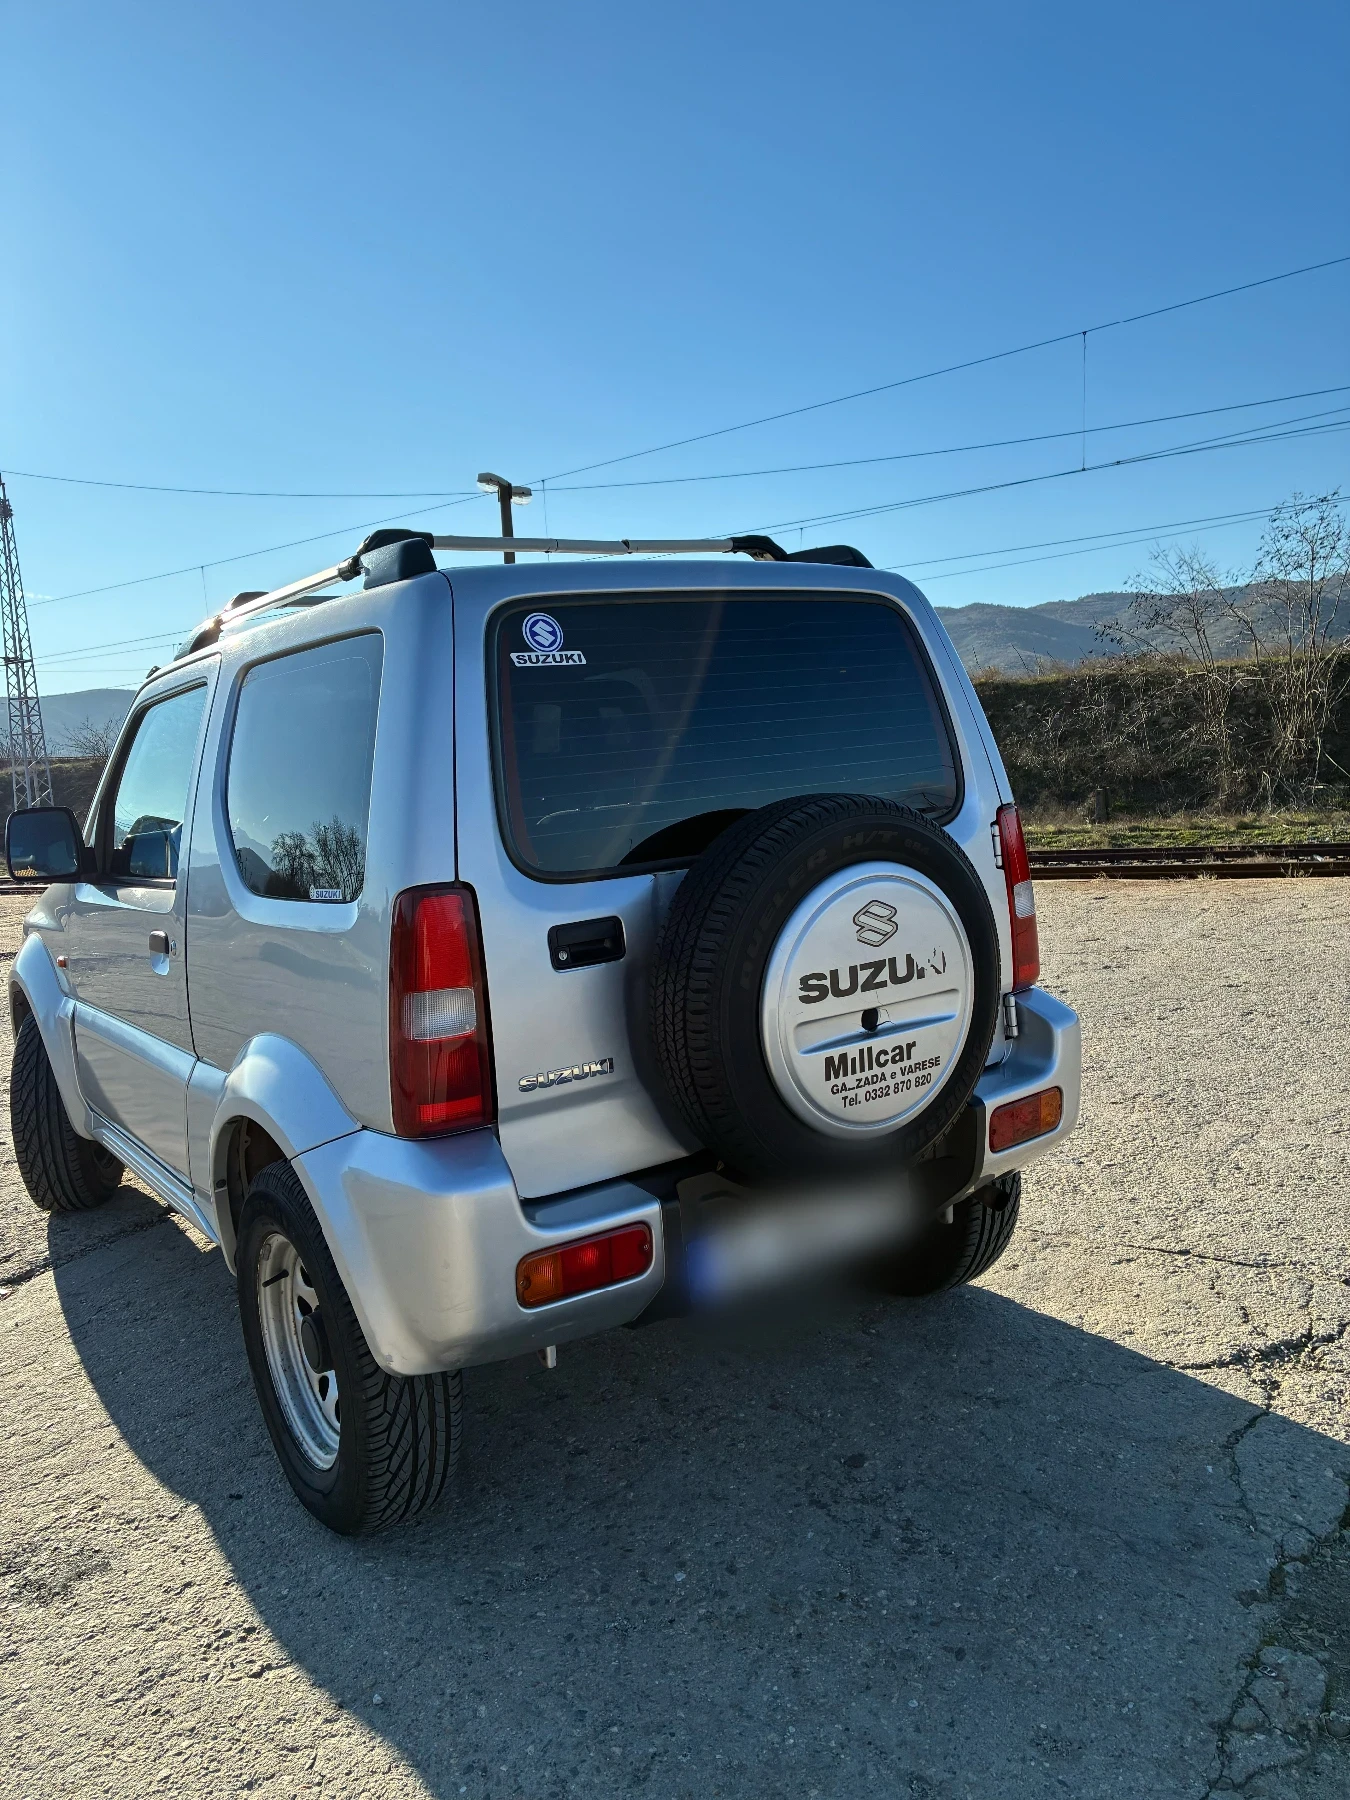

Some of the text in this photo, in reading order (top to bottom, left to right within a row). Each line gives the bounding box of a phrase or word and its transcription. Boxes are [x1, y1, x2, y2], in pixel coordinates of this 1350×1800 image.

[515, 654, 582, 665] SUZUKI
[841, 830, 899, 849] H/T
[315, 890, 341, 899] SUZUKI
[824, 1041, 916, 1082] Millcar
[890, 1071, 897, 1080] e
[899, 1055, 941, 1077] VARESE
[518, 1058, 614, 1092] SUZUKI
[841, 1072, 932, 1109] Tel. 0332 870 820
